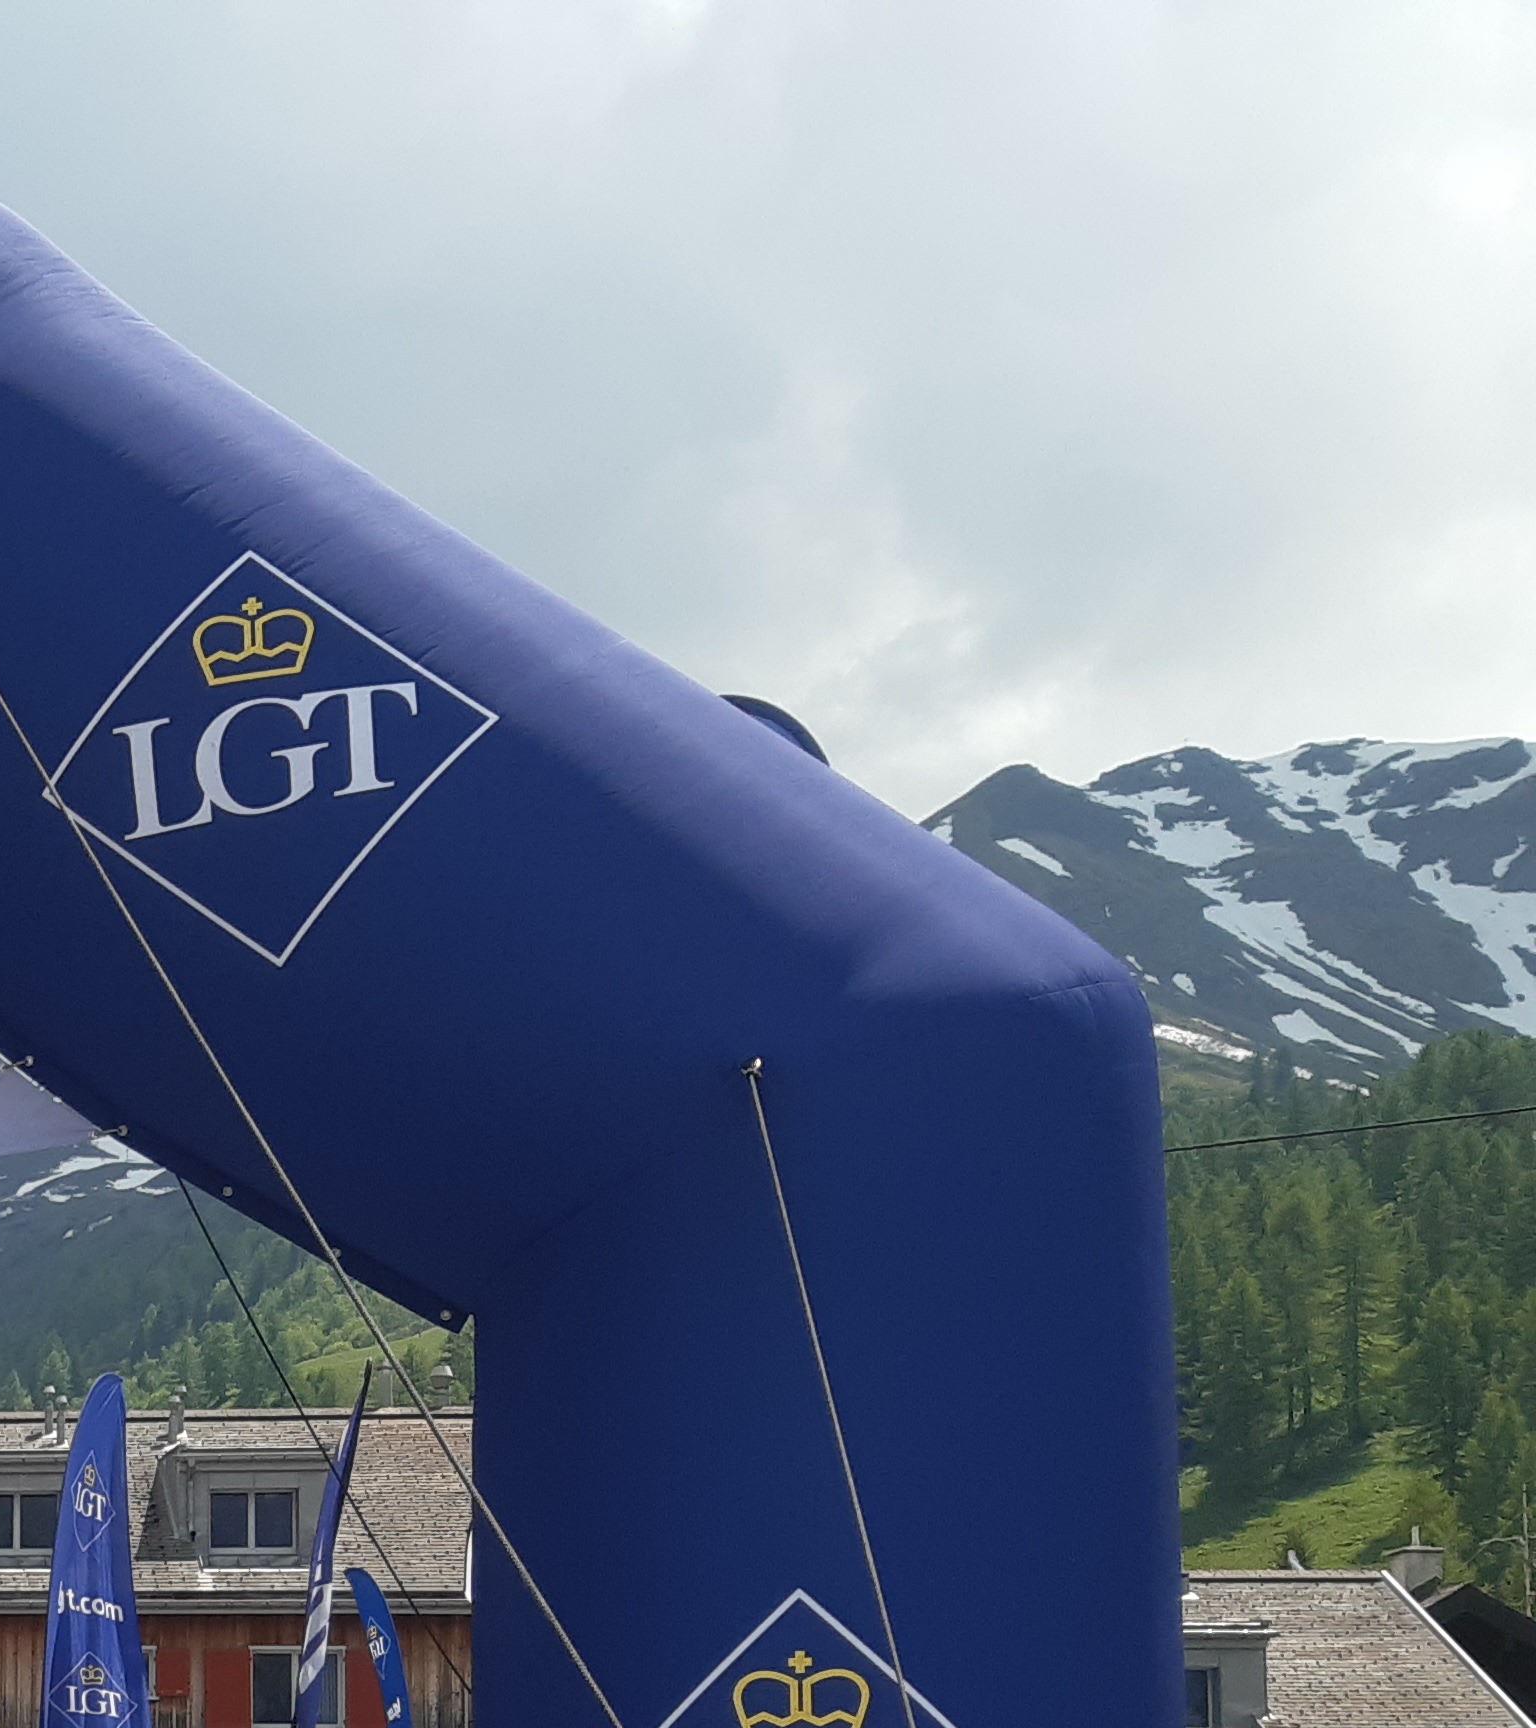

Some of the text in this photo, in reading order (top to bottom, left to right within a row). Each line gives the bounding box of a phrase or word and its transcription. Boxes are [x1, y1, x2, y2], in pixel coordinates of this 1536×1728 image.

[112, 681, 418, 841] LGT
[74, 1481, 107, 1522] LGT
[65, 1685, 122, 1718] LGT
